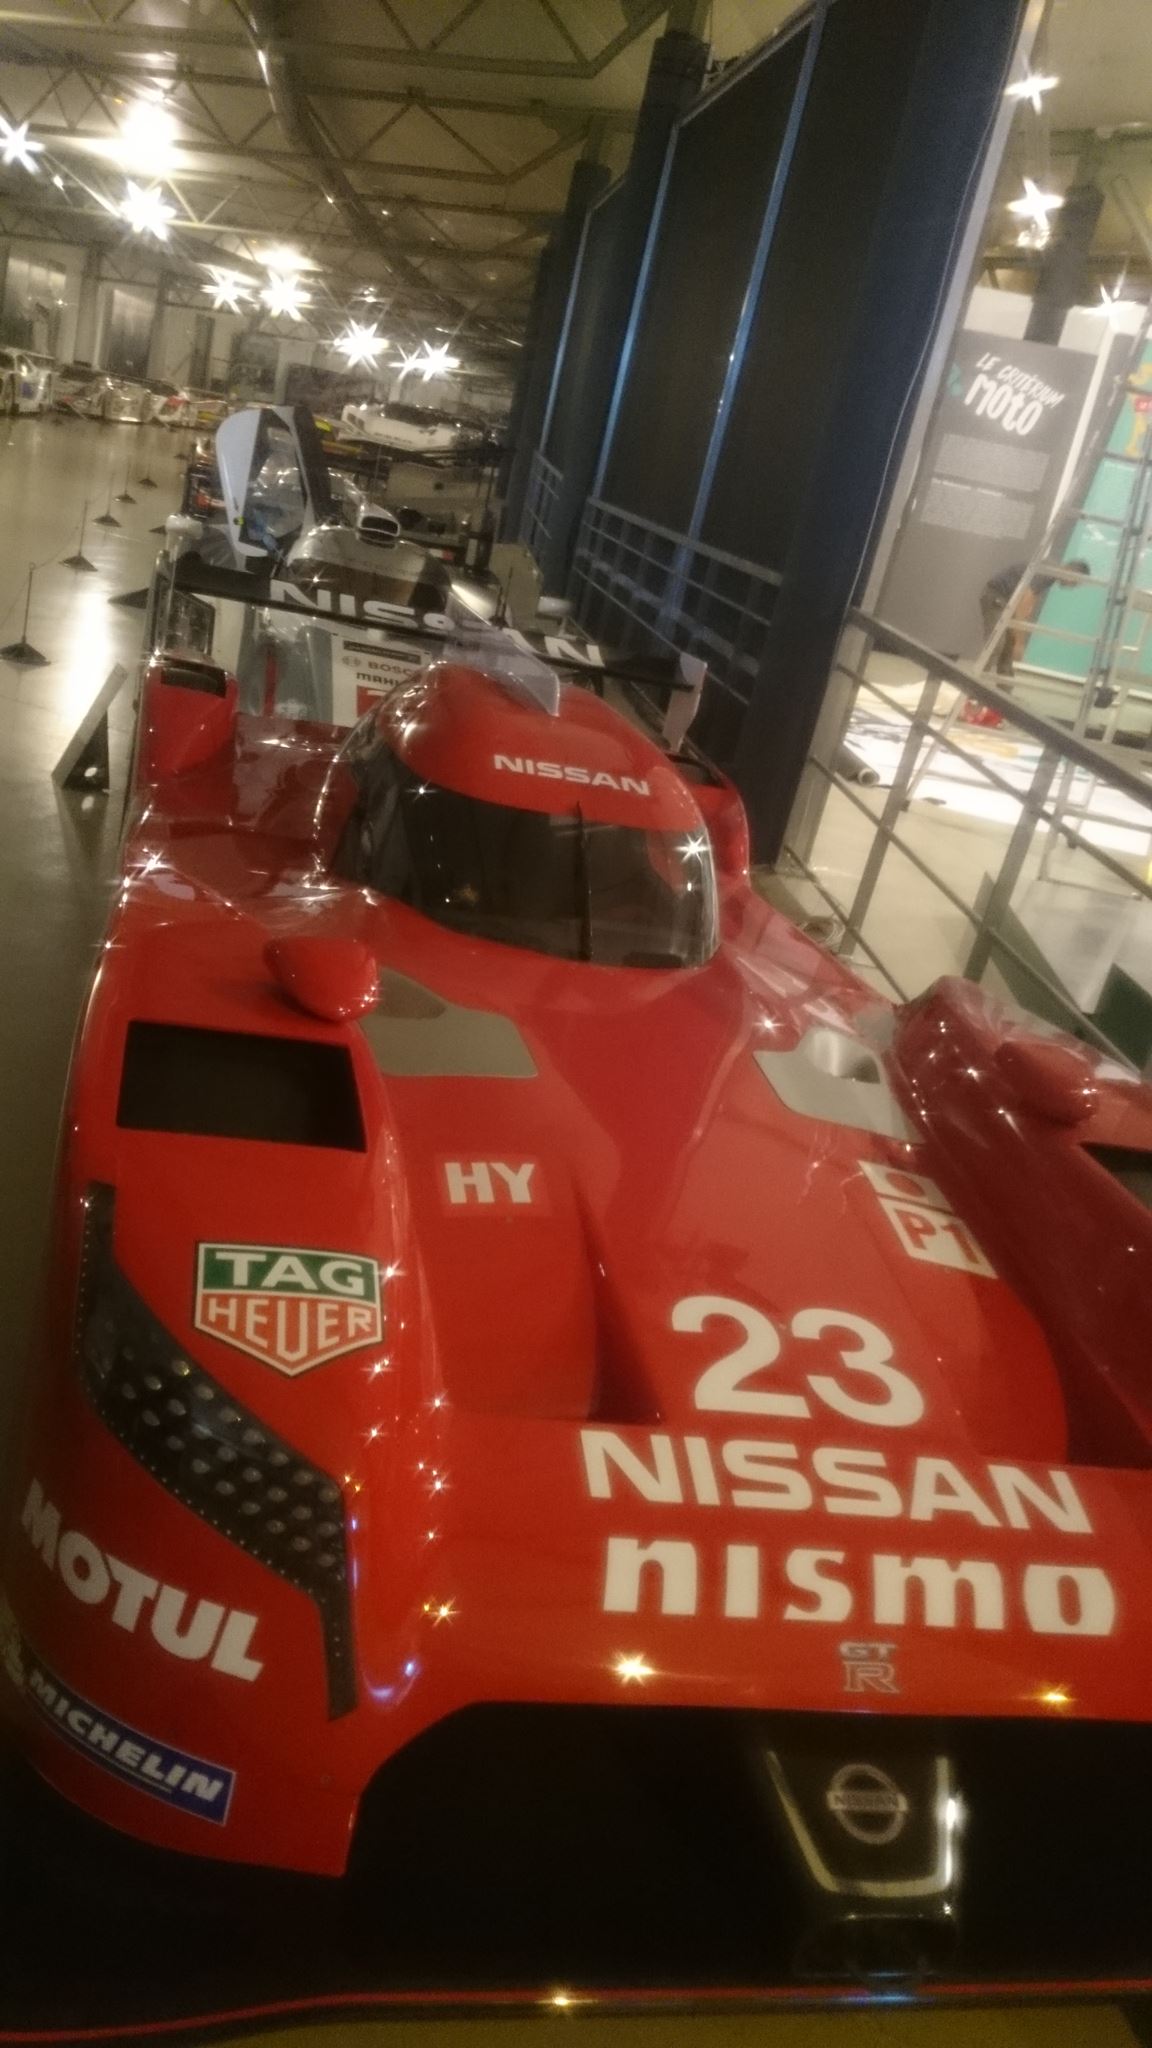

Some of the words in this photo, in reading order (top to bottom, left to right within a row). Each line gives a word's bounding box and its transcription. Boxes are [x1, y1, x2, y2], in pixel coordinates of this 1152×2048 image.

[976, 352, 1001, 371] LE
[494, 754, 651, 796] NISSAN
[444, 1162, 535, 1204] HY
[894, 1208, 980, 1265] P1
[215, 1251, 365, 1296] TAG
[208, 1298, 372, 1361] HEUER
[671, 1295, 924, 1427] 23
[580, 1430, 1093, 1534] NISSAN
[21, 1477, 263, 1682] MOTUL
[603, 1537, 1115, 1636] nismo
[839, 1642, 897, 1660] GT
[842, 1662, 900, 1694] R
[29, 1669, 224, 1802] MICHELIN
